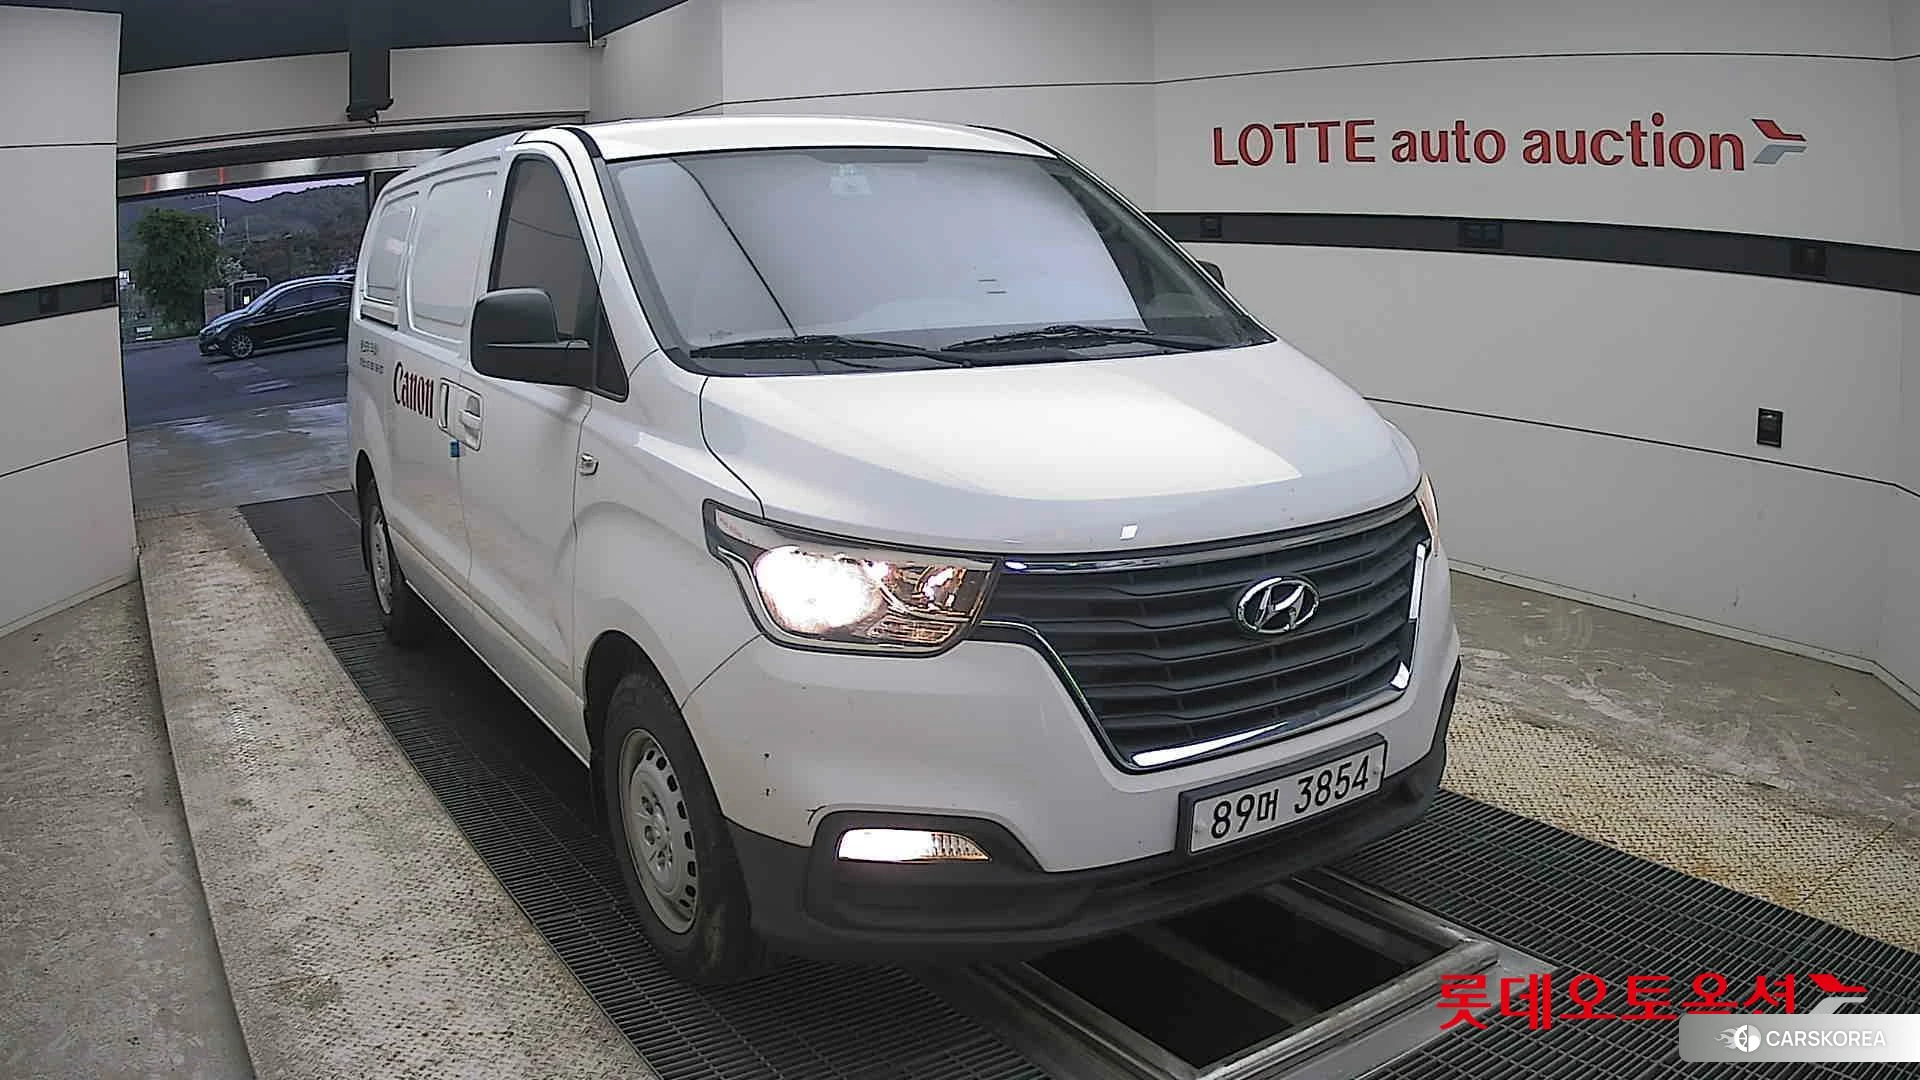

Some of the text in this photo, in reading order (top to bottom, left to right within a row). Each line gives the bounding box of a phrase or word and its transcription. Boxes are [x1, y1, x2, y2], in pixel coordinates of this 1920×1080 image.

[1213, 112, 1745, 171] LOTTE auto auction
[393, 361, 434, 419] Canon
[1211, 755, 1370, 839] 89머 3854
